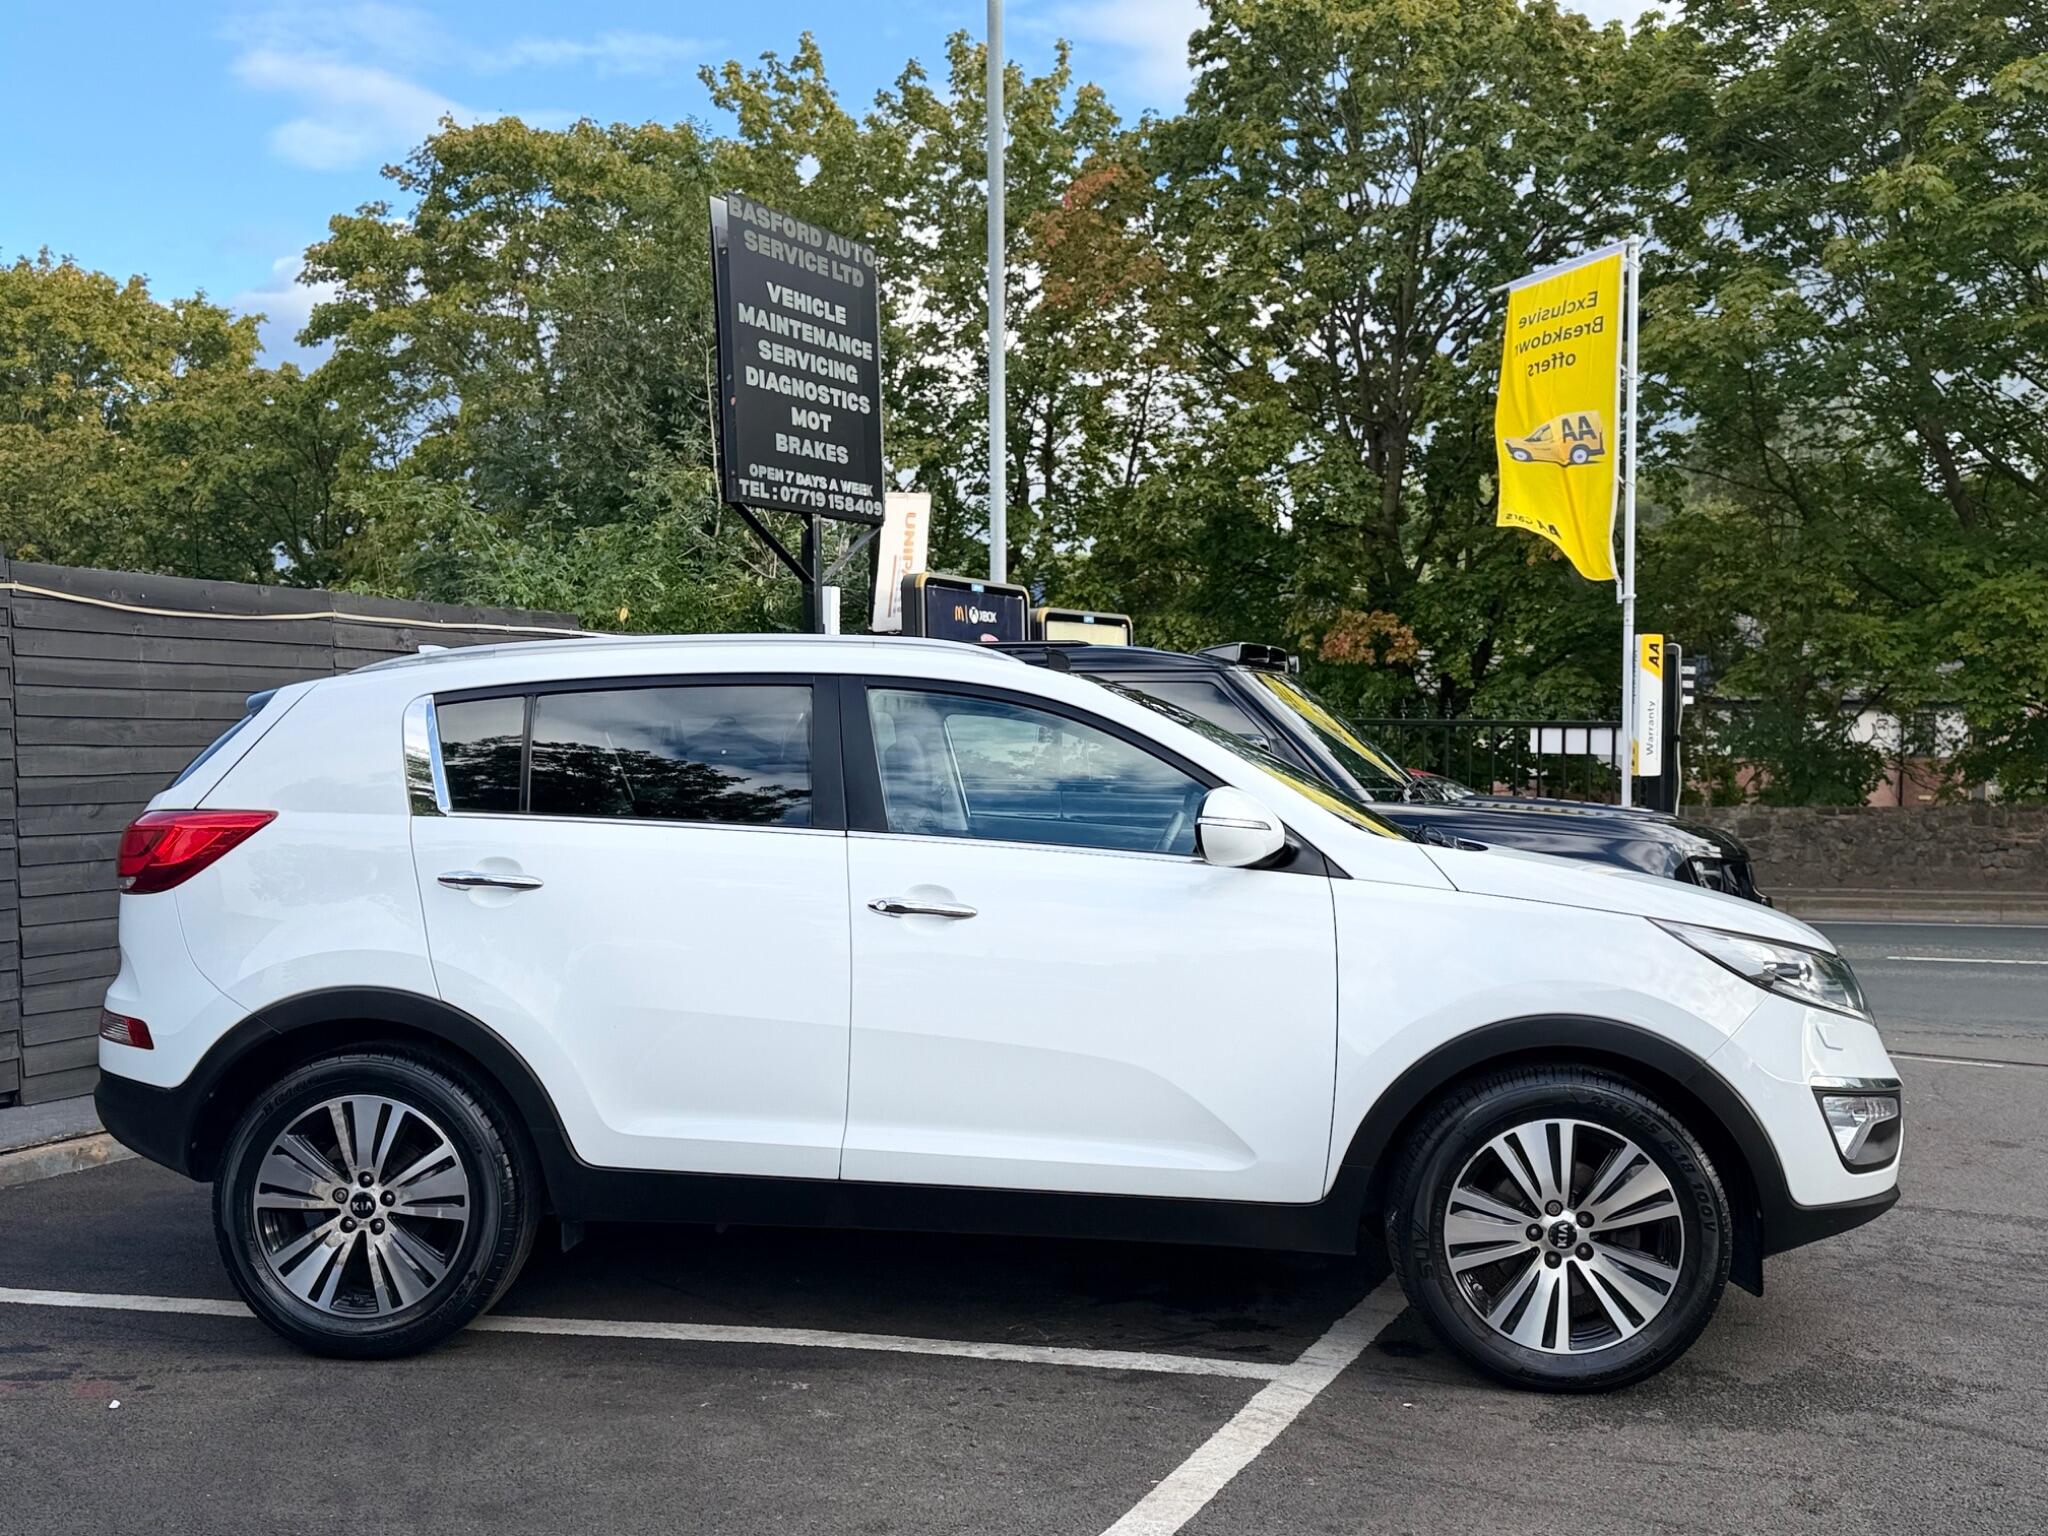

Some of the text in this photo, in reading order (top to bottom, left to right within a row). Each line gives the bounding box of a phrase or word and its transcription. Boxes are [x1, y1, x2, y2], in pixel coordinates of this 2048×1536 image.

[728, 194, 876, 268] BASFORD AUTO
[743, 229, 865, 288] SERVICE LTD
[766, 281, 847, 326] VEHICLE
[738, 302, 873, 362] MAINTENANCE
[758, 339, 858, 384] SERVICING
[745, 365, 871, 415] DIAGNOSTICS
[791, 406, 832, 433] MOT
[775, 433, 849, 464] BRAKES
[749, 463, 874, 497] OPEN 7 DAYS A WEEK
[780, 485, 826, 507] 07719
[828, 494, 883, 516] 158409
[1646, 643, 1660, 756] AA Warranty
[352, 1201, 374, 1211] KIA
[1556, 1223, 1569, 1247] KIA
